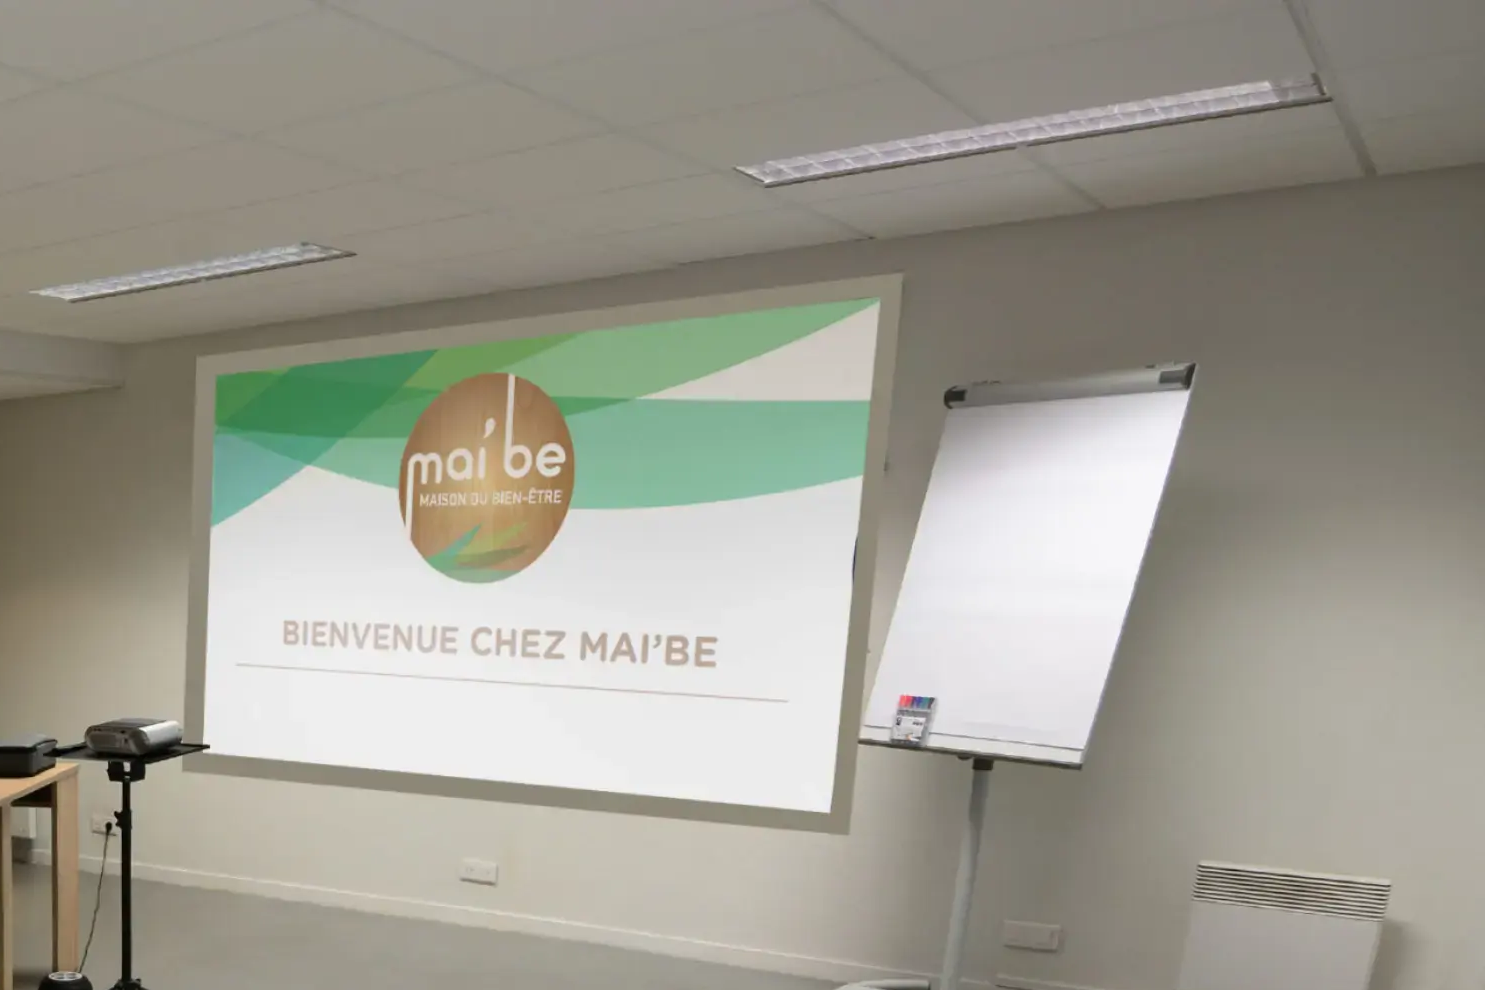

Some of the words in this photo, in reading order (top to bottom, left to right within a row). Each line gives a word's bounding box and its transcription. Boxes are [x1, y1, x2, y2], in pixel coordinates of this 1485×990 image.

[419, 492, 467, 507] MAISON
[471, 491, 488, 506] DU
[492, 487, 563, 505] BIEN-ÊTRE
[282, 619, 459, 655] BIENVENUE
[470, 626, 566, 660] CHEZ
[579, 631, 719, 668] MAI'BE
